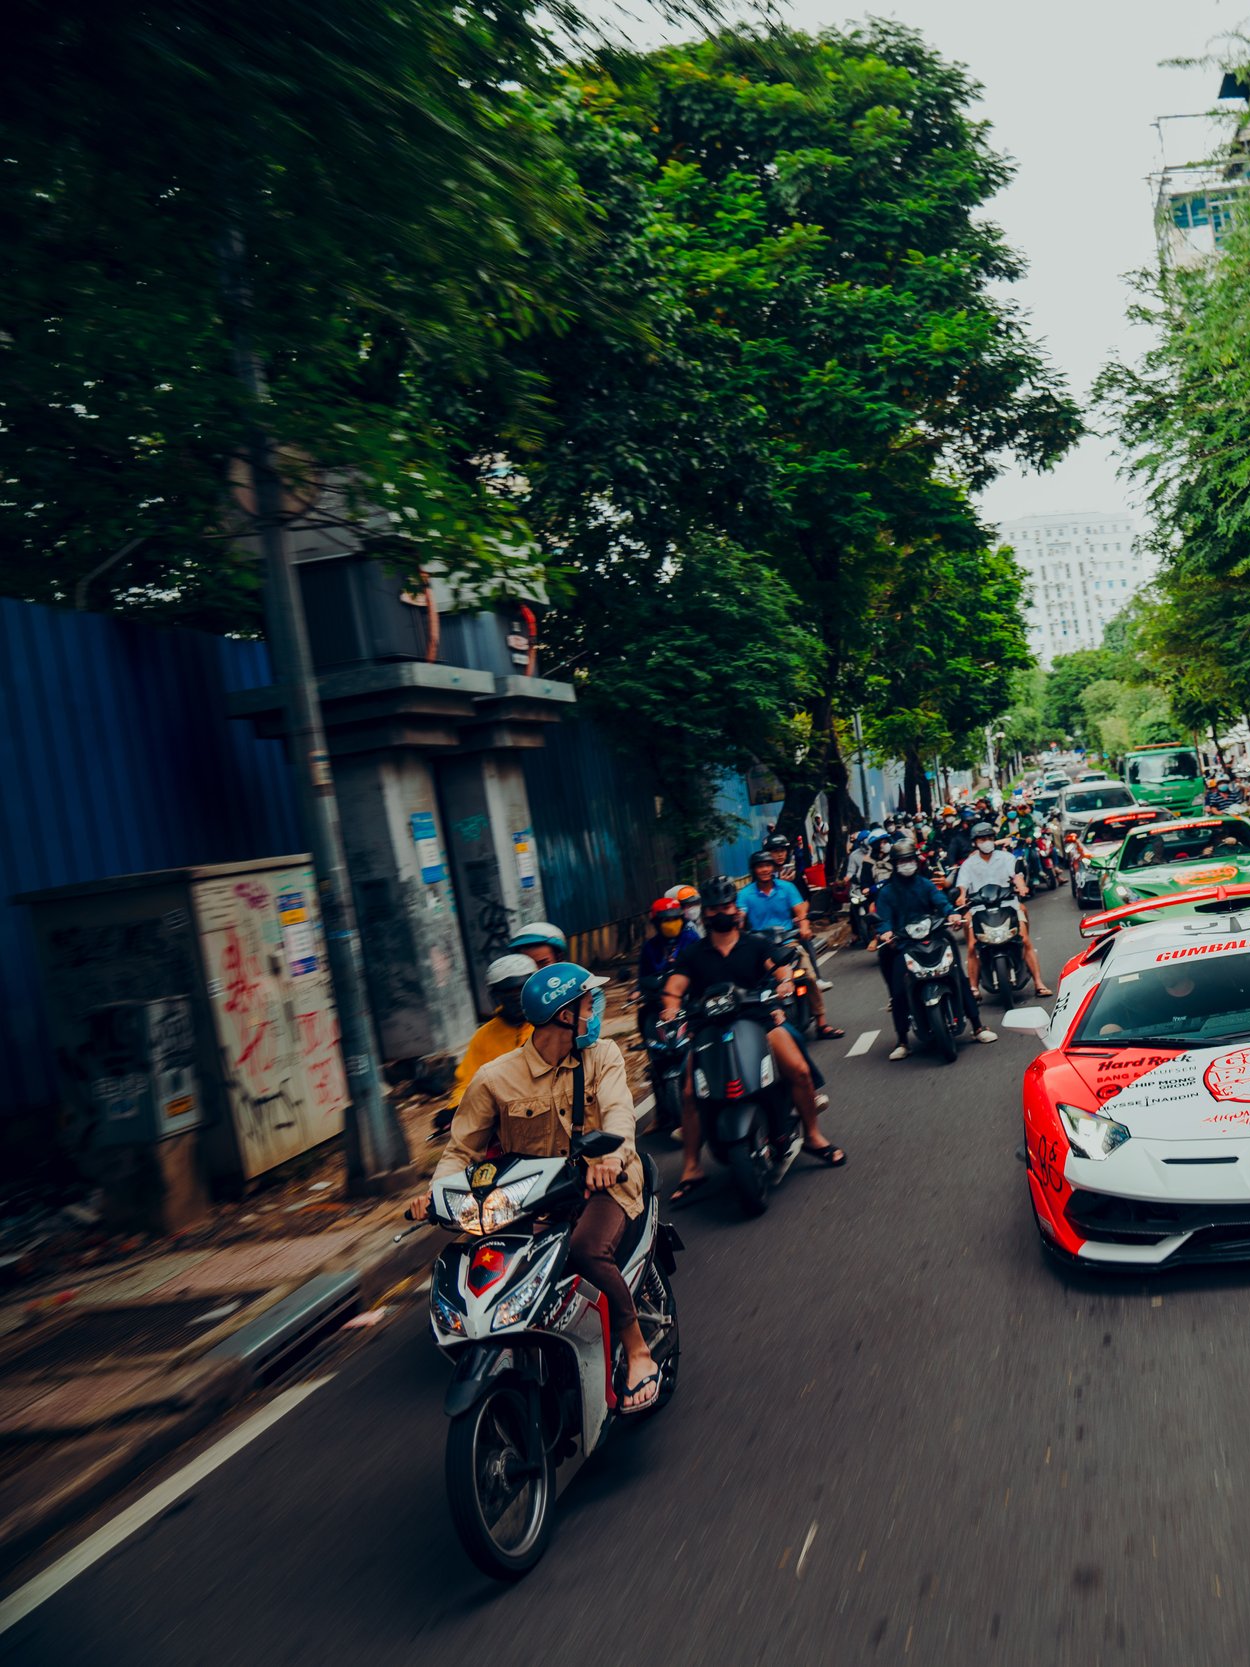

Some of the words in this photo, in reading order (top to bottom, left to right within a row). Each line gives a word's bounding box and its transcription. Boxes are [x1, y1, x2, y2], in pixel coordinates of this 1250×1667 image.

[542, 977, 577, 1005] Casper
[1098, 1057, 1146, 1071] Hard
[1148, 1054, 1193, 1067] Rock
[1097, 1072, 1129, 1082] BANG
[1144, 1066, 1197, 1076] OLUFSEN
[1127, 1081, 1155, 1089] CHIP
[1158, 1077, 1196, 1085] MONG
[1159, 1081, 1196, 1090] GROUP
[1098, 1101, 1142, 1112] ULYSSE
[1151, 1092, 1199, 1103] NARDIN
